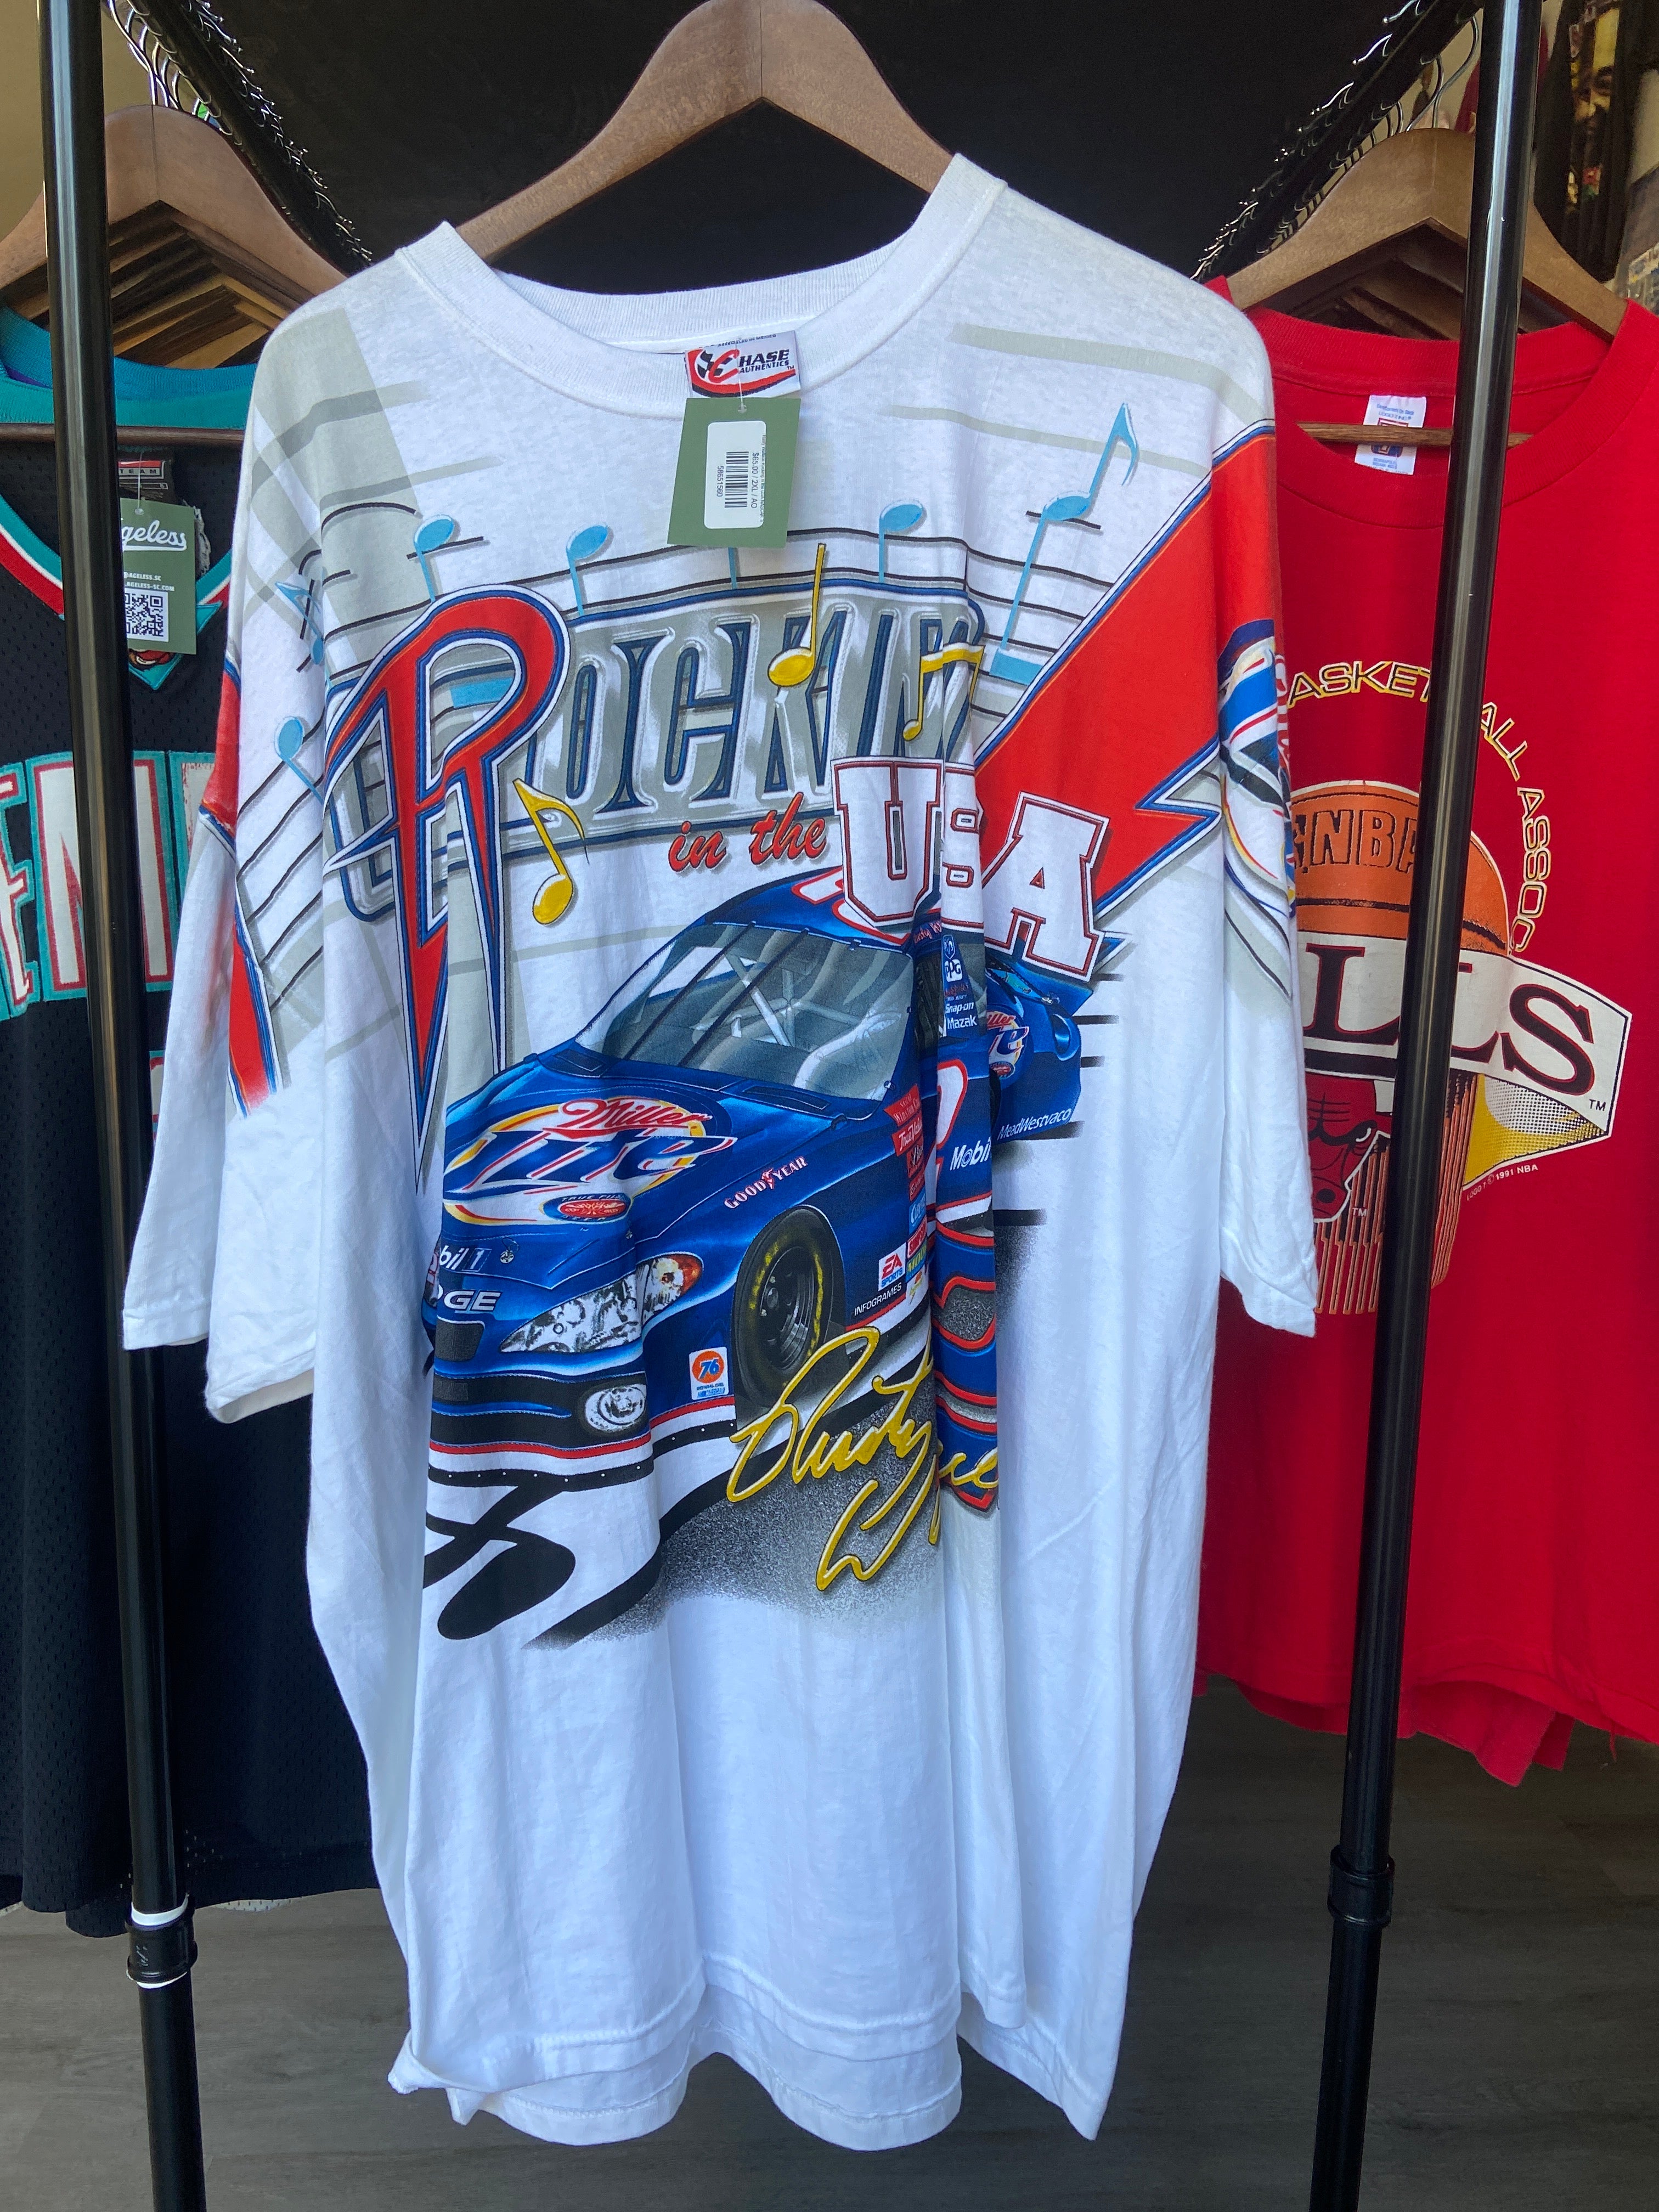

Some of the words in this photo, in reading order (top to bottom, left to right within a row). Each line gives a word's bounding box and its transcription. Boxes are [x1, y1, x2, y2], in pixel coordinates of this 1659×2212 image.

[708, 349, 789, 383] CHASE
[740, 359, 789, 374] AUTHENTICS
[121, 520, 187, 551] geless
[668, 820, 726, 872] in
[748, 791, 827, 865] the
[830, 757, 1110, 983] USA
[945, 959, 962, 980] PPG
[945, 1002, 974, 1014] Snap-on
[987, 1013, 1016, 1026] iller
[947, 1015, 978, 1030] Mazak
[556, 1097, 714, 1130] Miller
[1589, 1098, 1607, 1112] TM
[996, 1108, 1072, 1141] MeadWestvaco
[1516, 1164, 1538, 1175] NBA
[724, 1155, 809, 1209] GOODYEAR
[1352, 1207, 1367, 1217] TM
[881, 1252, 902, 1279] EA
[881, 1267, 903, 1288] SPORTS
[854, 1282, 902, 1316] INFOGRAMES
[697, 1357, 720, 1380] 76
